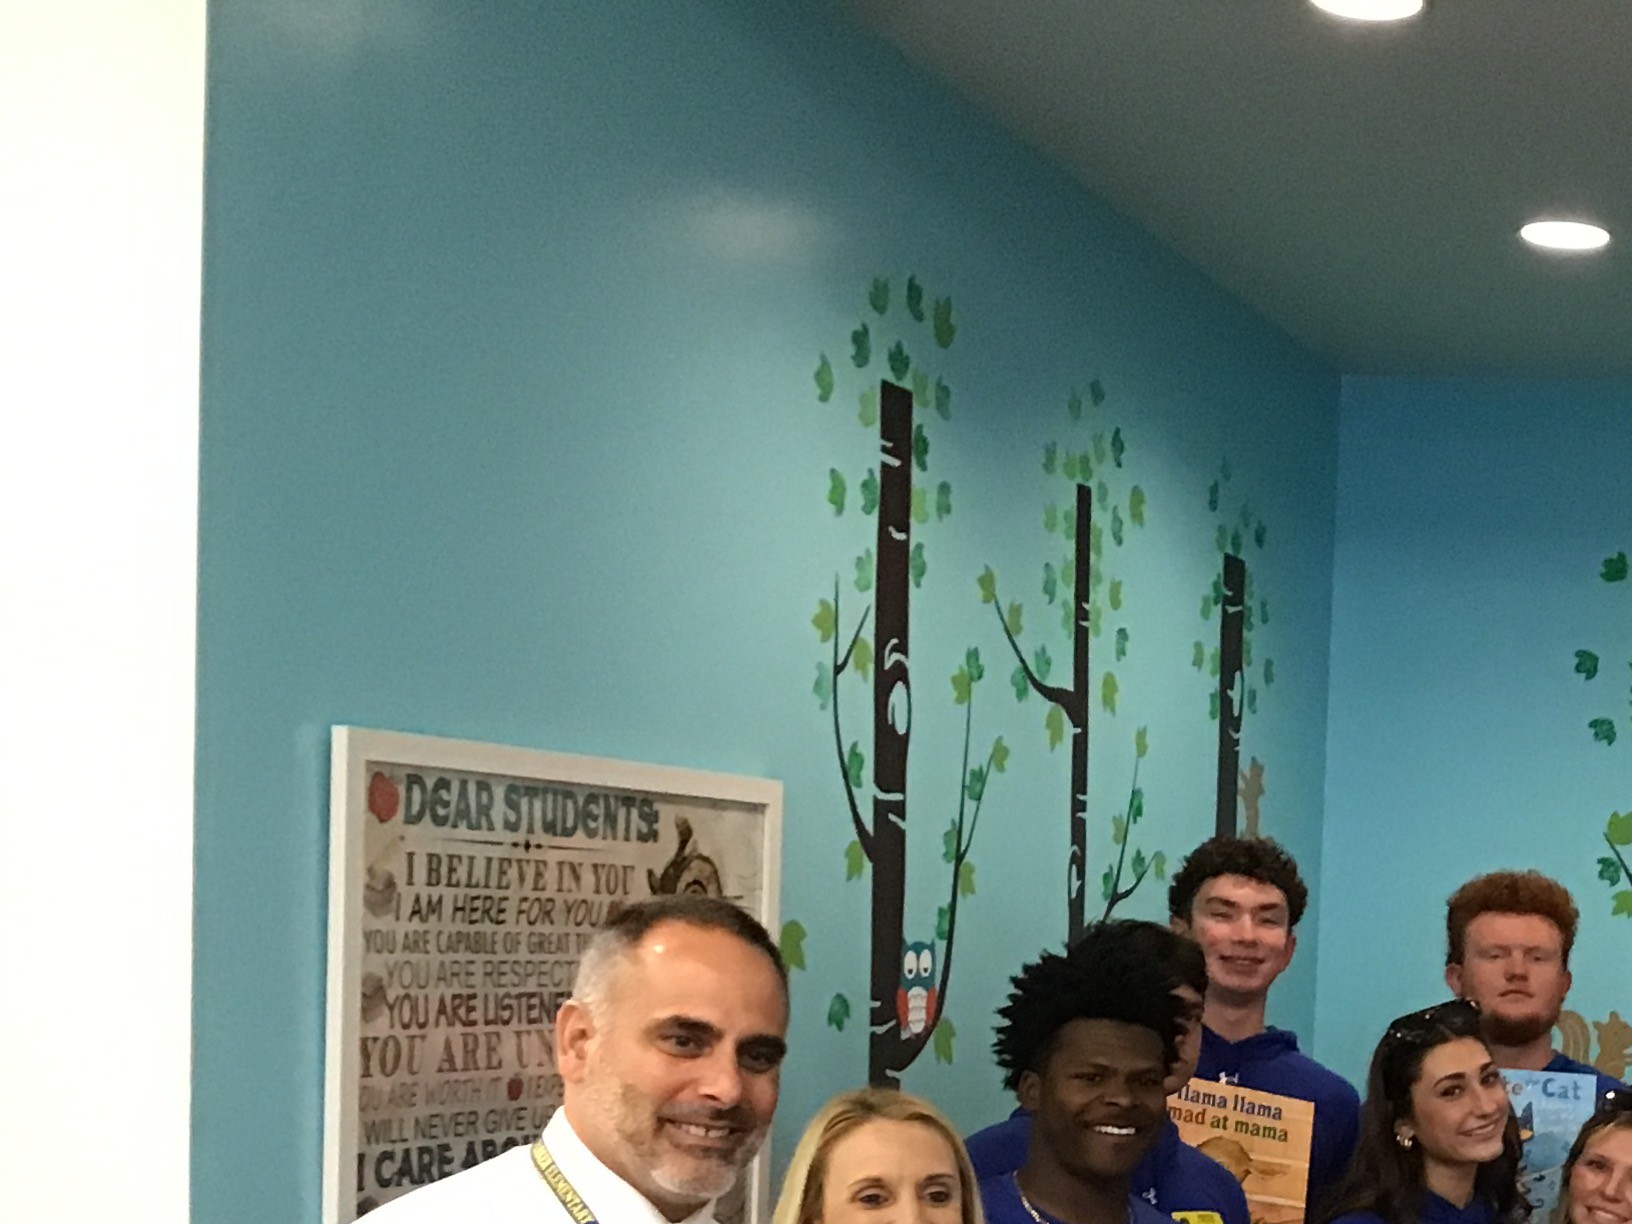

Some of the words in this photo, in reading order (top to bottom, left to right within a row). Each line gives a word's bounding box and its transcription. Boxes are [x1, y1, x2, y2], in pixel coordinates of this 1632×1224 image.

[403, 773, 495, 832] DEAR
[405, 851, 415, 886] I
[425, 852, 548, 891] BELIEVE
[555, 861, 586, 893] IN
[592, 863, 635, 896] YOU
[408, 895, 443, 924] AM
[452, 895, 507, 925] HERE
[515, 897, 556, 926] FOR
[564, 900, 602, 928] YOU
[364, 928, 396, 955] YOU
[403, 930, 430, 954] ARE
[436, 931, 497, 955] CAPABLE
[504, 931, 521, 955] OF
[527, 932, 570, 955] GREAT
[386, 960, 430, 990] YOU
[437, 960, 476, 988] ARE
[483, 960, 578, 988] RESPECT
[385, 993, 429, 1029] YOU
[435, 992, 478, 1028] ARE
[483, 991, 572, 1027] LISTENE
[360, 1034, 426, 1078] YOU
[437, 1031, 502, 1073] ARE
[1177, 1085, 1227, 1109] llama
[1233, 1095, 1282, 1120] llama
[1542, 1078, 1582, 1100] Cat
[363, 1117, 408, 1145] WILL
[414, 1111, 479, 1139] NEVER
[484, 1107, 528, 1134] GIVE
[1169, 1106, 1206, 1125] mad
[1210, 1114, 1228, 1130] at
[1234, 1120, 1288, 1142] mama
[375, 1143, 454, 1188] CARE
